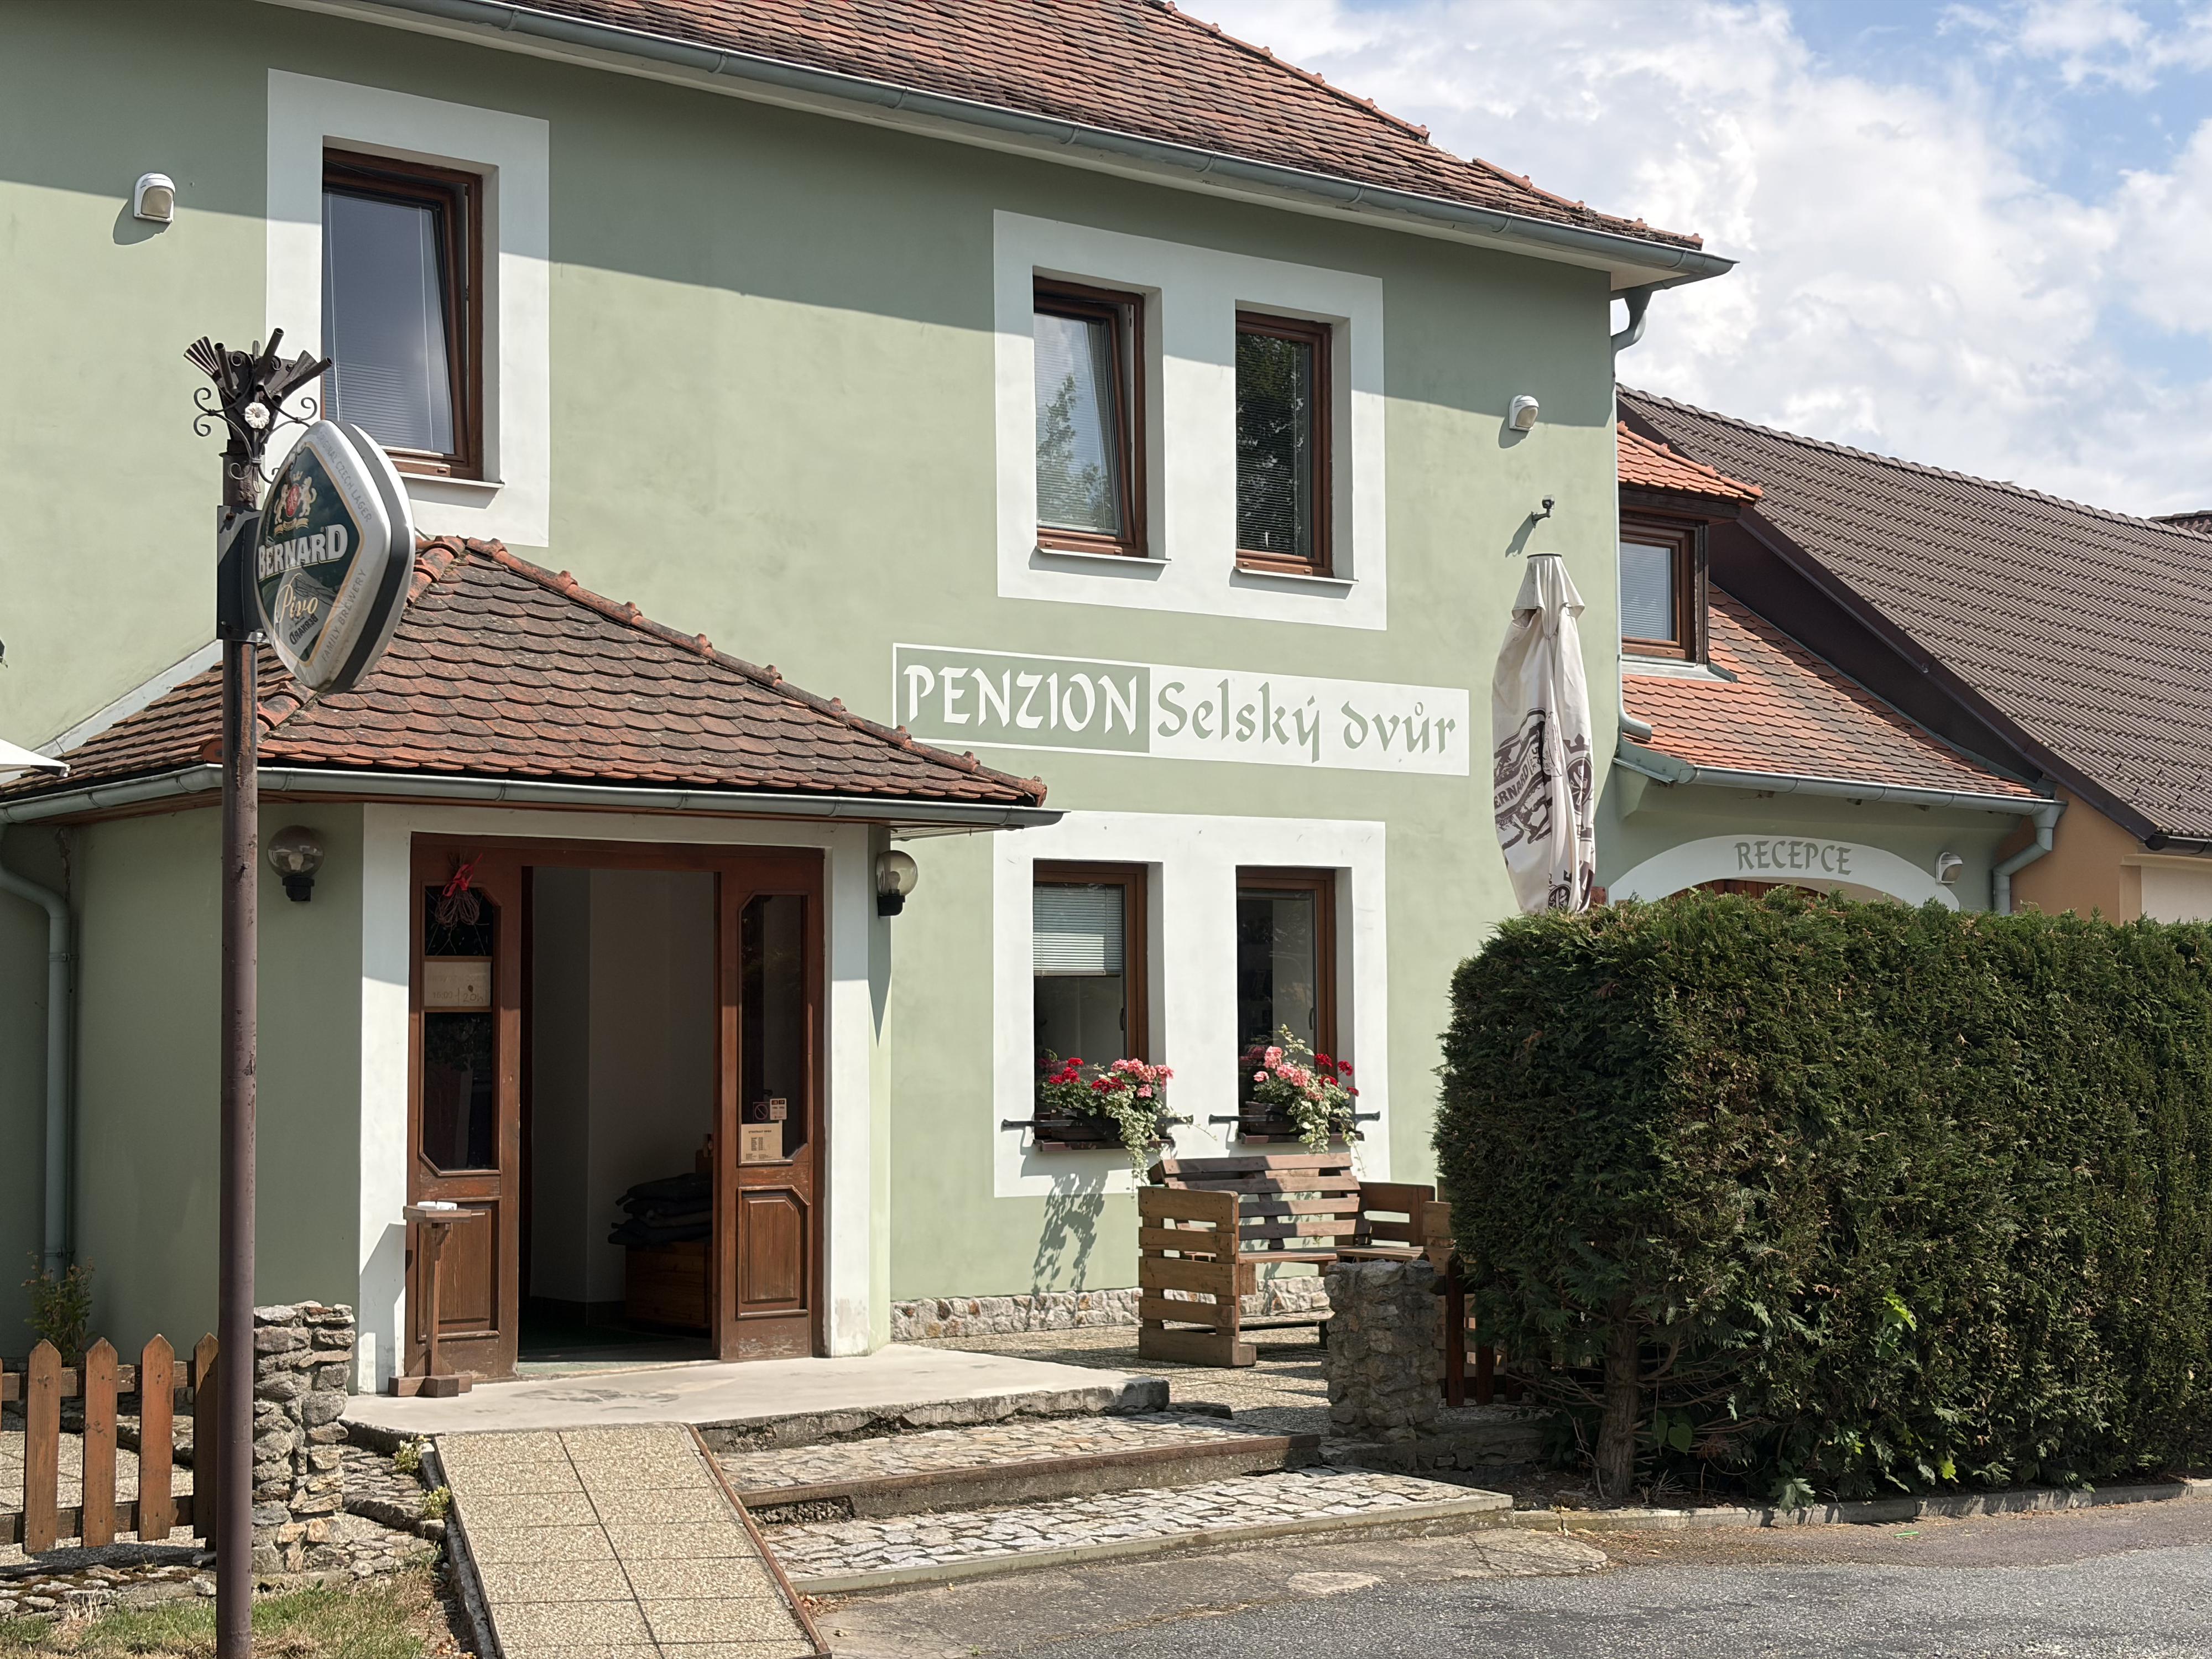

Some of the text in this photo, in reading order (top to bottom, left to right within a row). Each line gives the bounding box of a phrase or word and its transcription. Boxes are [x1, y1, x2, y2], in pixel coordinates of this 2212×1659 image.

[336, 461, 354, 489] CZECH
[351, 489, 372, 522] LAGER
[258, 524, 348, 581] BERNARD
[274, 572, 319, 623] Pivo
[321, 569, 367, 662] FAMILY BREWERY
[904, 665, 1455, 763] PENZION Selský dvůr
[1494, 764, 1528, 810] ERNARD
[1734, 840, 1852, 875] RECEPCE
